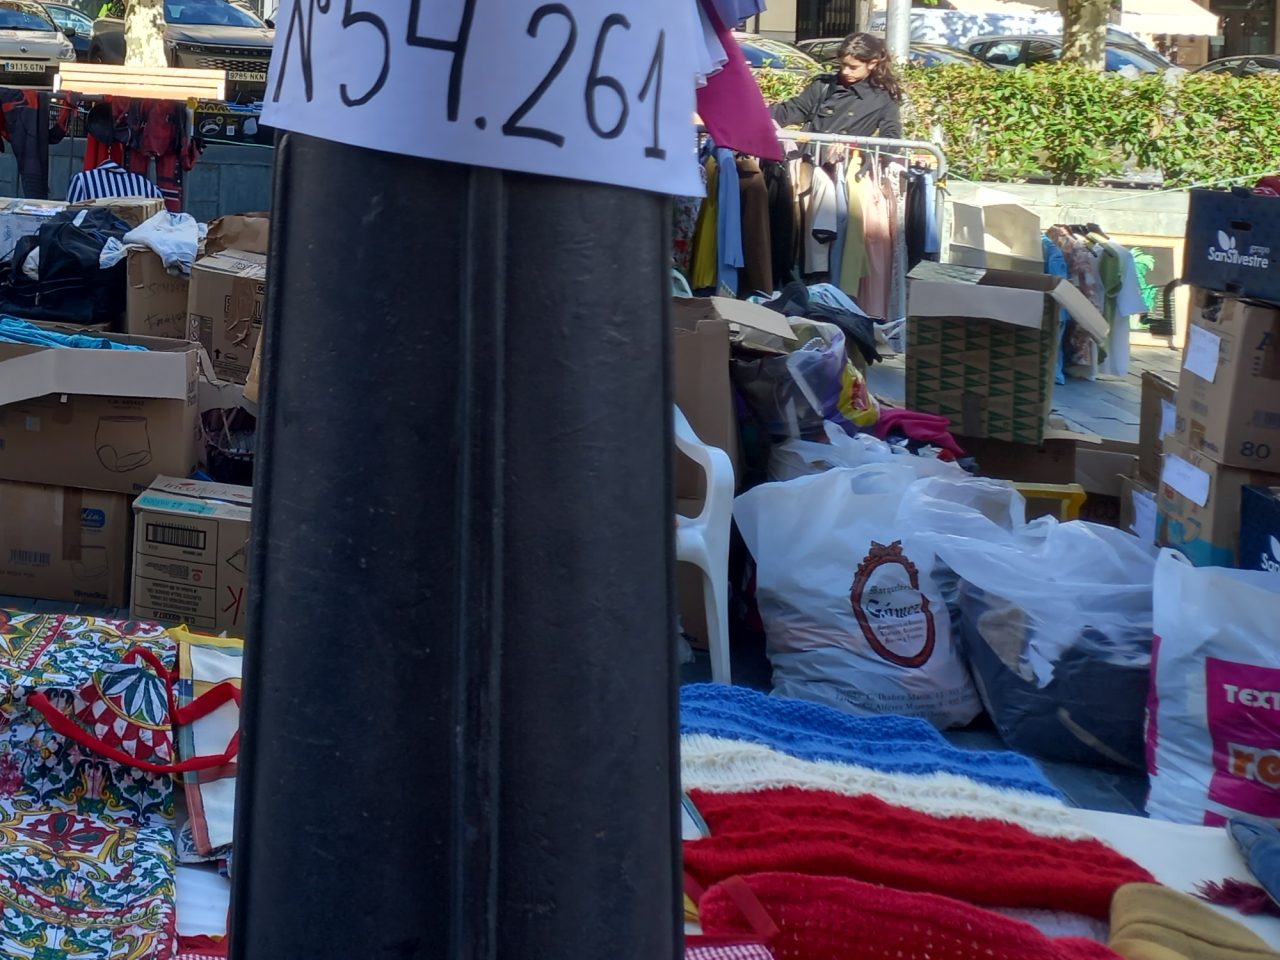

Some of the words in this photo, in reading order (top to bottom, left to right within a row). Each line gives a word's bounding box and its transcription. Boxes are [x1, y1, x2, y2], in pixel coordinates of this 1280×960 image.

[230, 72, 248, 80] 9785
[250, 73, 265, 81] NKN
[1208, 246, 1269, 268] SanSilvestre
[1240, 441, 1271, 460] 80
[1222, 684, 1280, 712] TEXT
